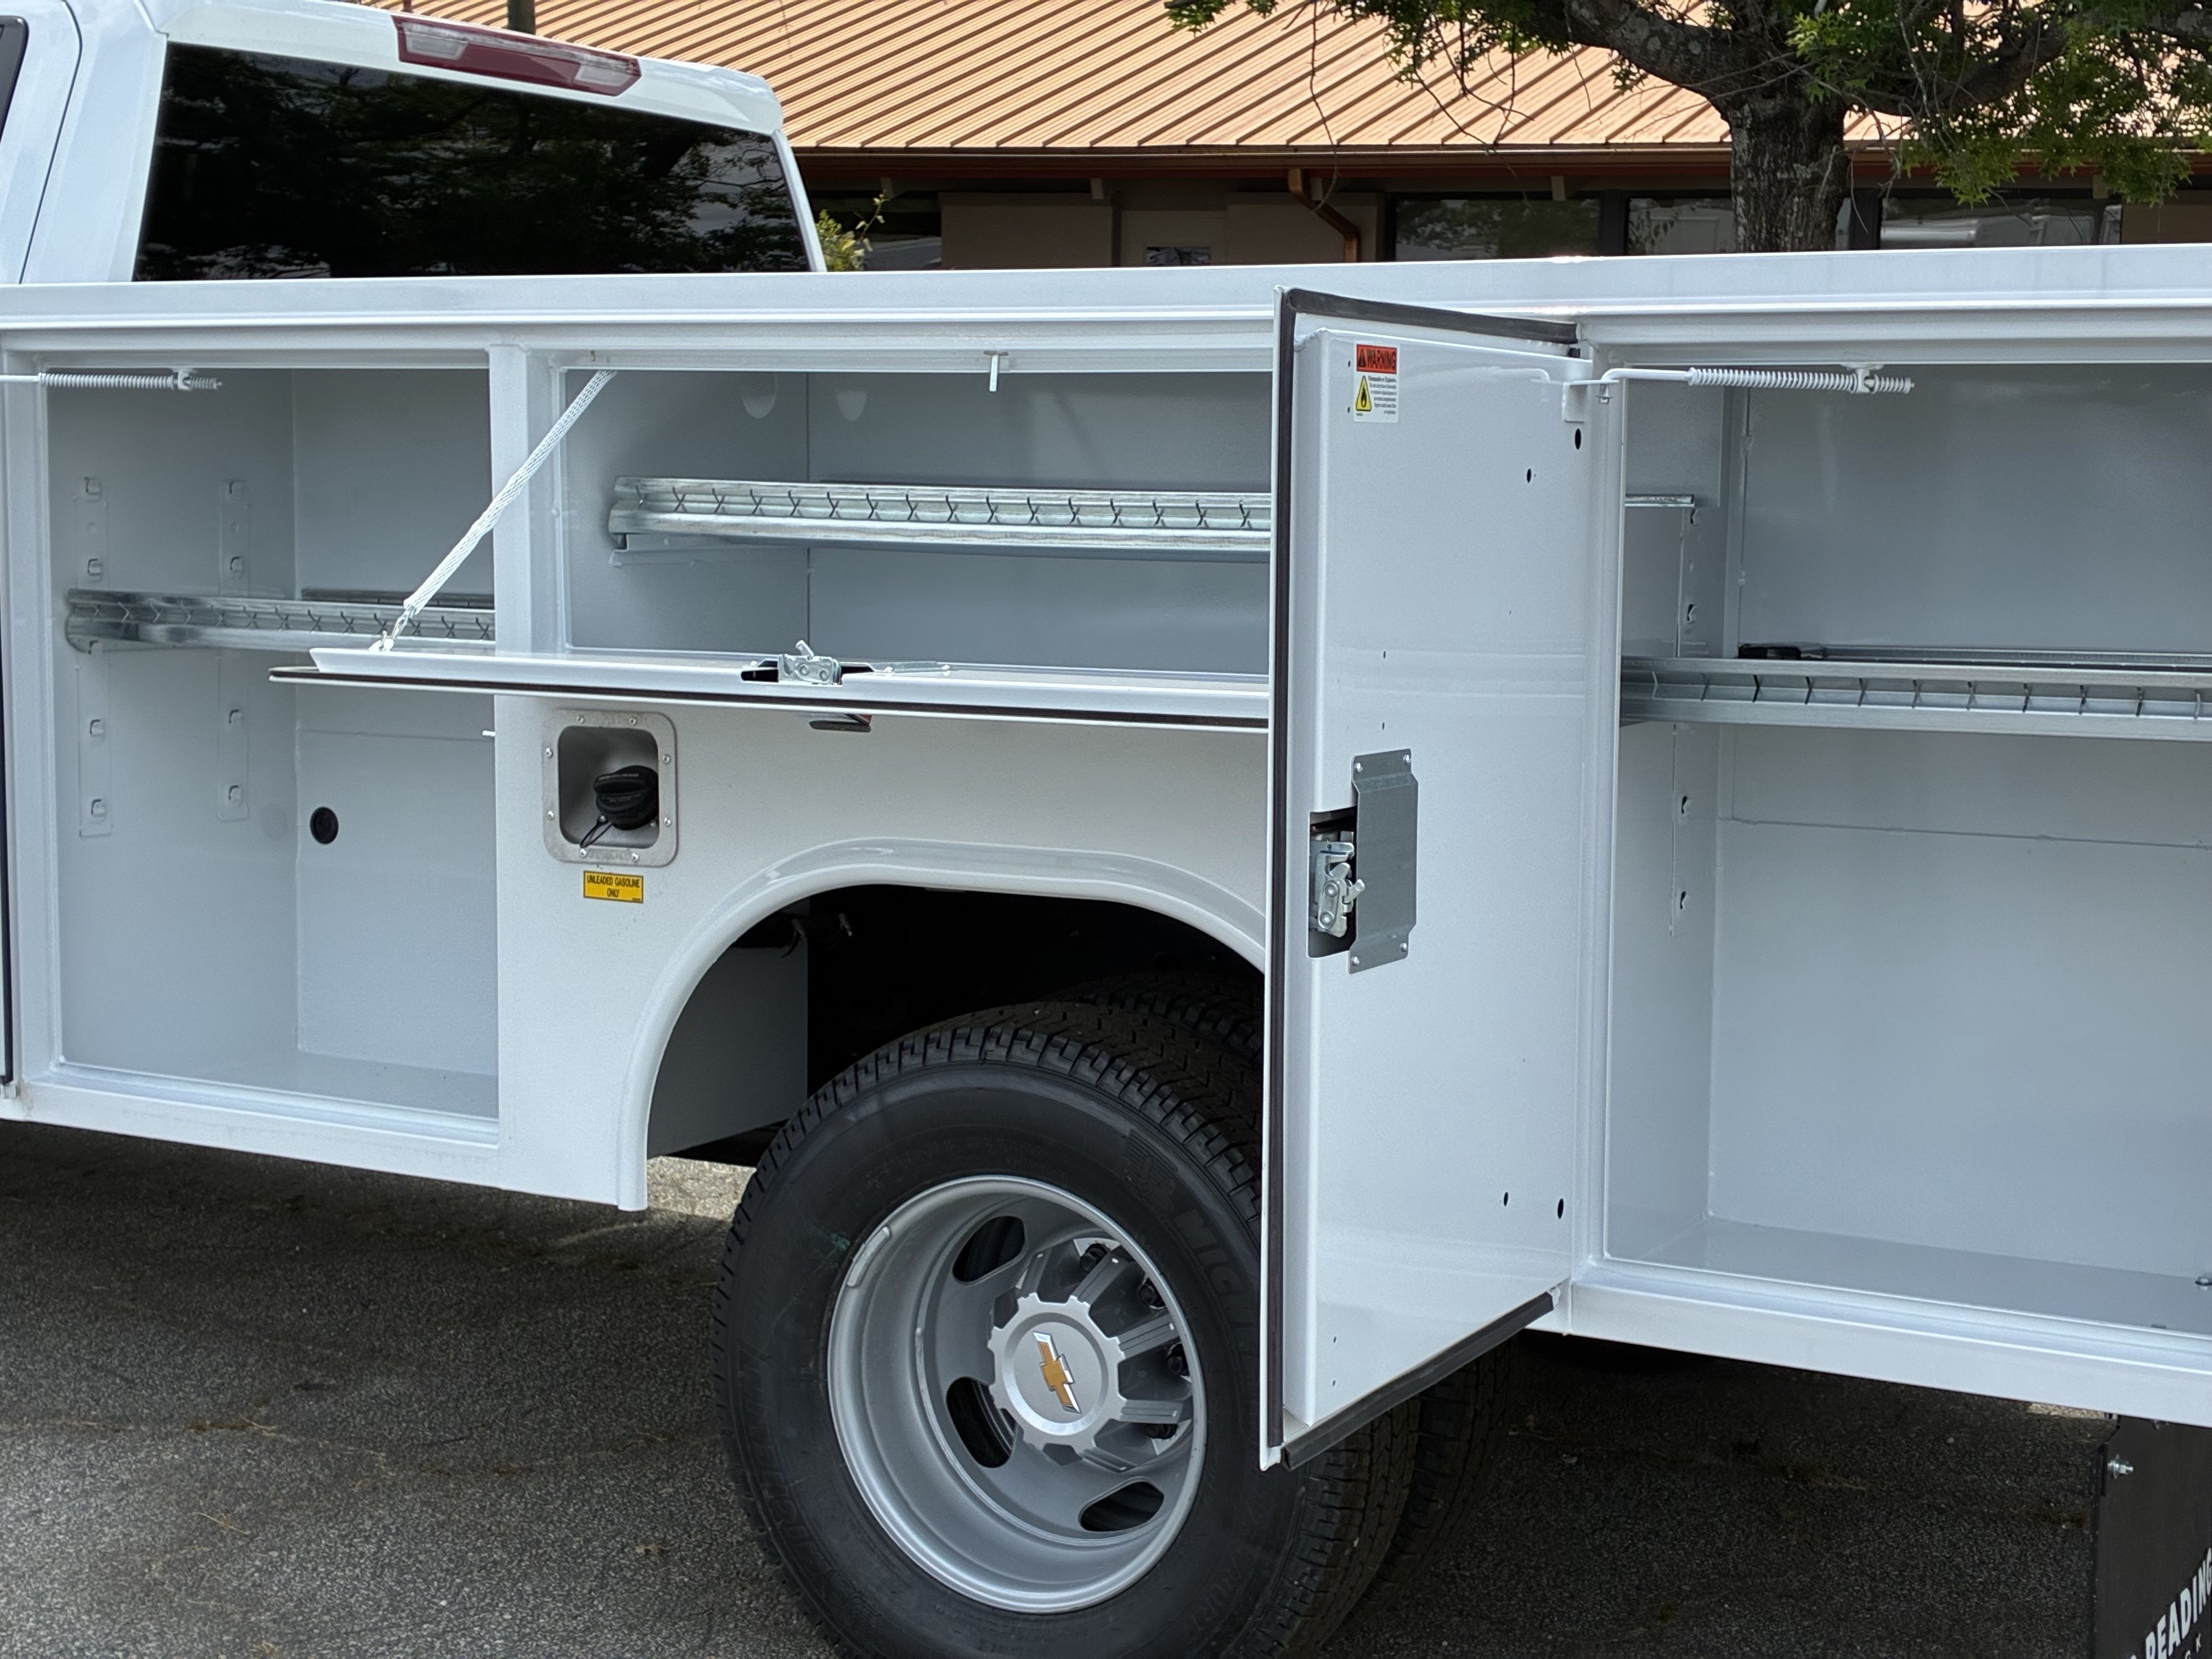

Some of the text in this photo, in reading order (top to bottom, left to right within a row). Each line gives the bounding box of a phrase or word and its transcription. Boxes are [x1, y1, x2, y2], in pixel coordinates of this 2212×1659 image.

[1367, 349, 1396, 370] WARNING
[586, 875, 640, 888] UNLEADED GASOLINE
[607, 888, 619, 898] ONLY
